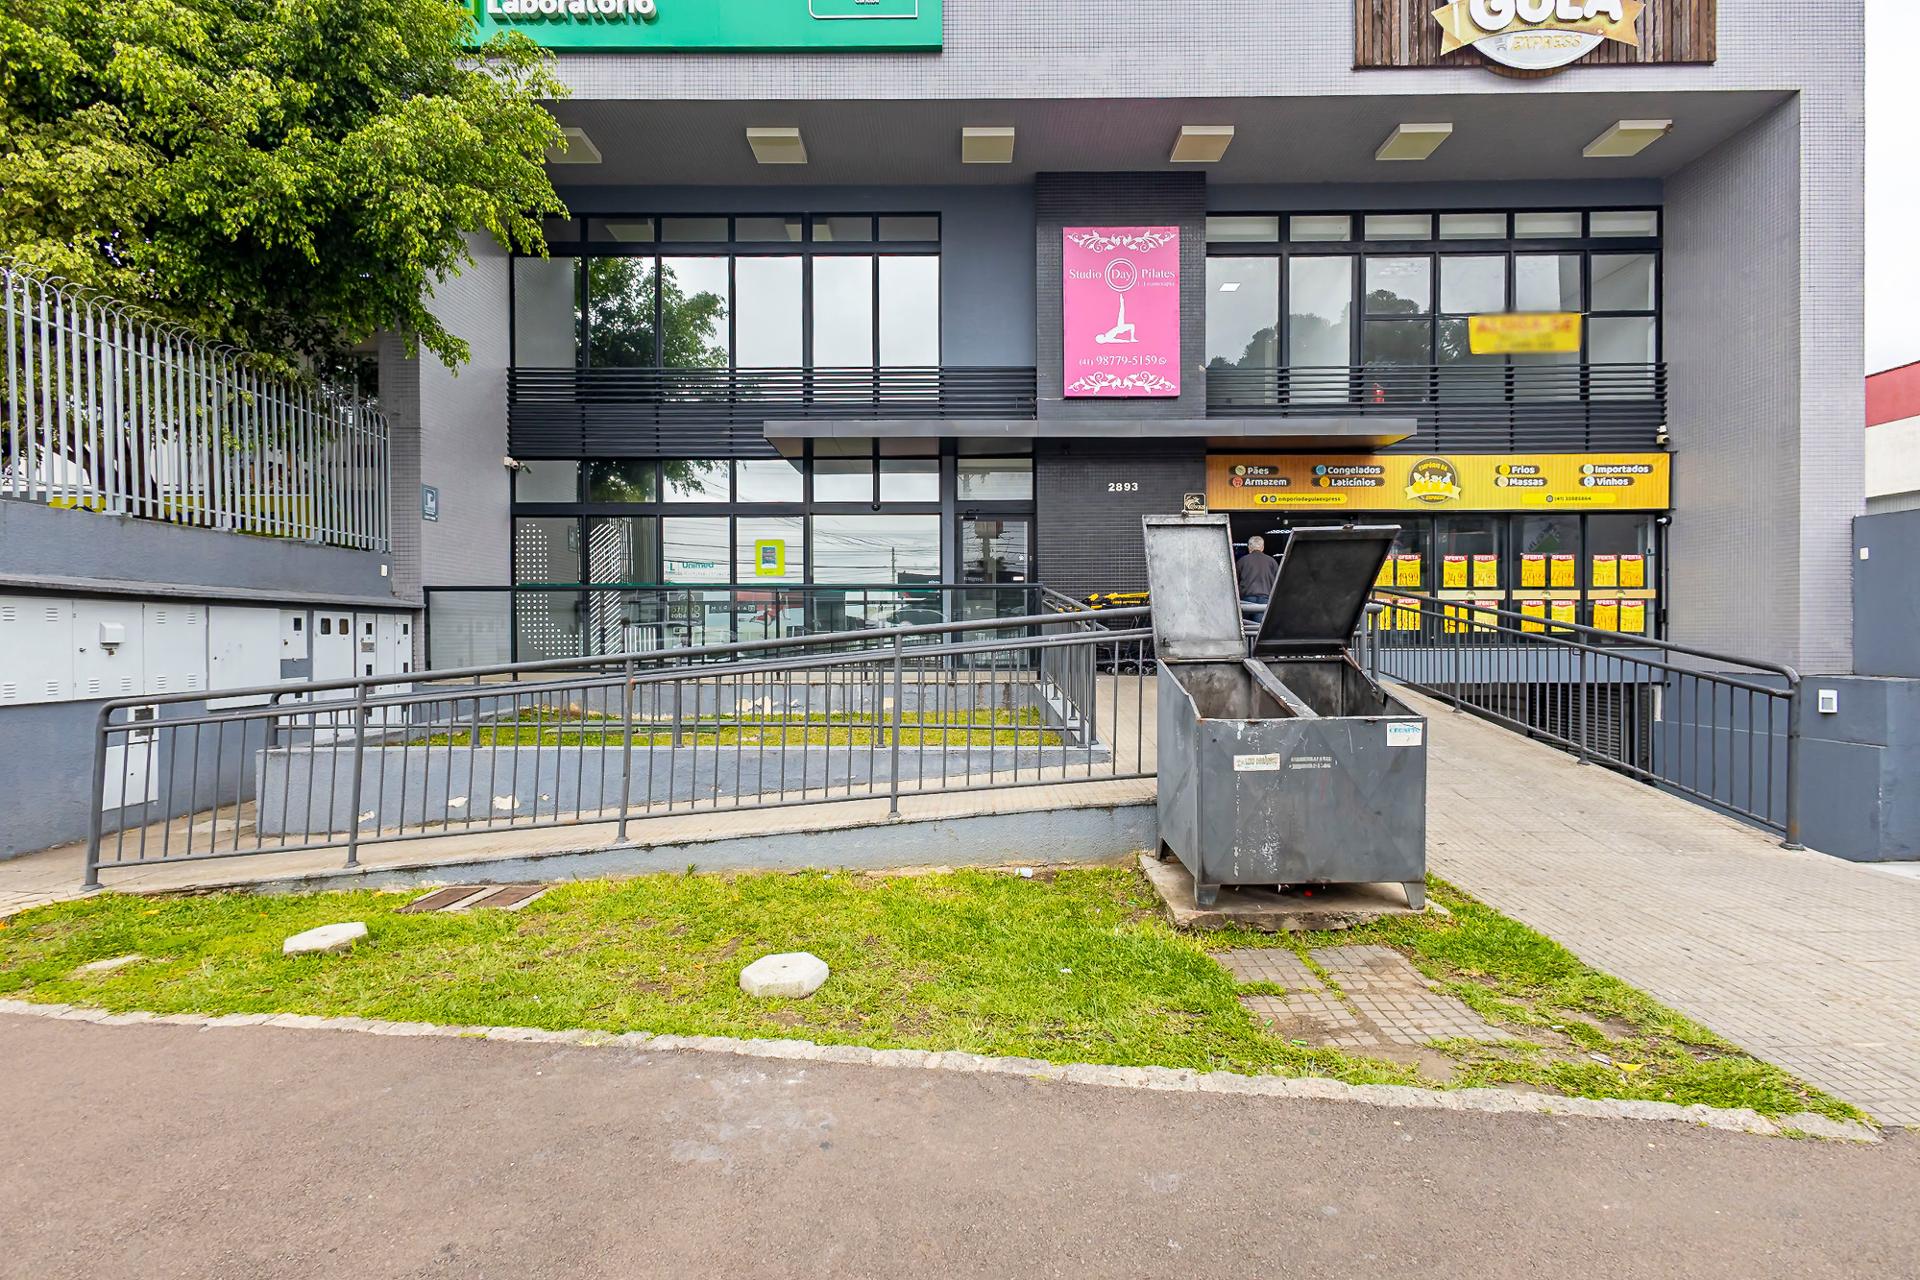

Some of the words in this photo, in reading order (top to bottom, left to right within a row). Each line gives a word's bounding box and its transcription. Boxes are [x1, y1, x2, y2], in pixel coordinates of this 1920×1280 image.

[1513, 35, 1582, 49] EXPRESS
[1069, 269, 1102, 279] Studio
[1111, 269, 1132, 281] Day
[1141, 268, 1175, 279] Pilates
[1096, 355, 1157, 366] 98779-5159
[1247, 466, 1269, 475] Pães
[1327, 466, 1381, 476] Congelados
[1511, 466, 1535, 475] Frios
[1595, 465, 1649, 475] Importados
[1244, 478, 1287, 486] Armazem
[1331, 478, 1376, 487] Laticínios
[1510, 478, 1543, 486] Massas
[1597, 477, 1629, 486] Vinhos
[1108, 482, 1138, 491] 2893
